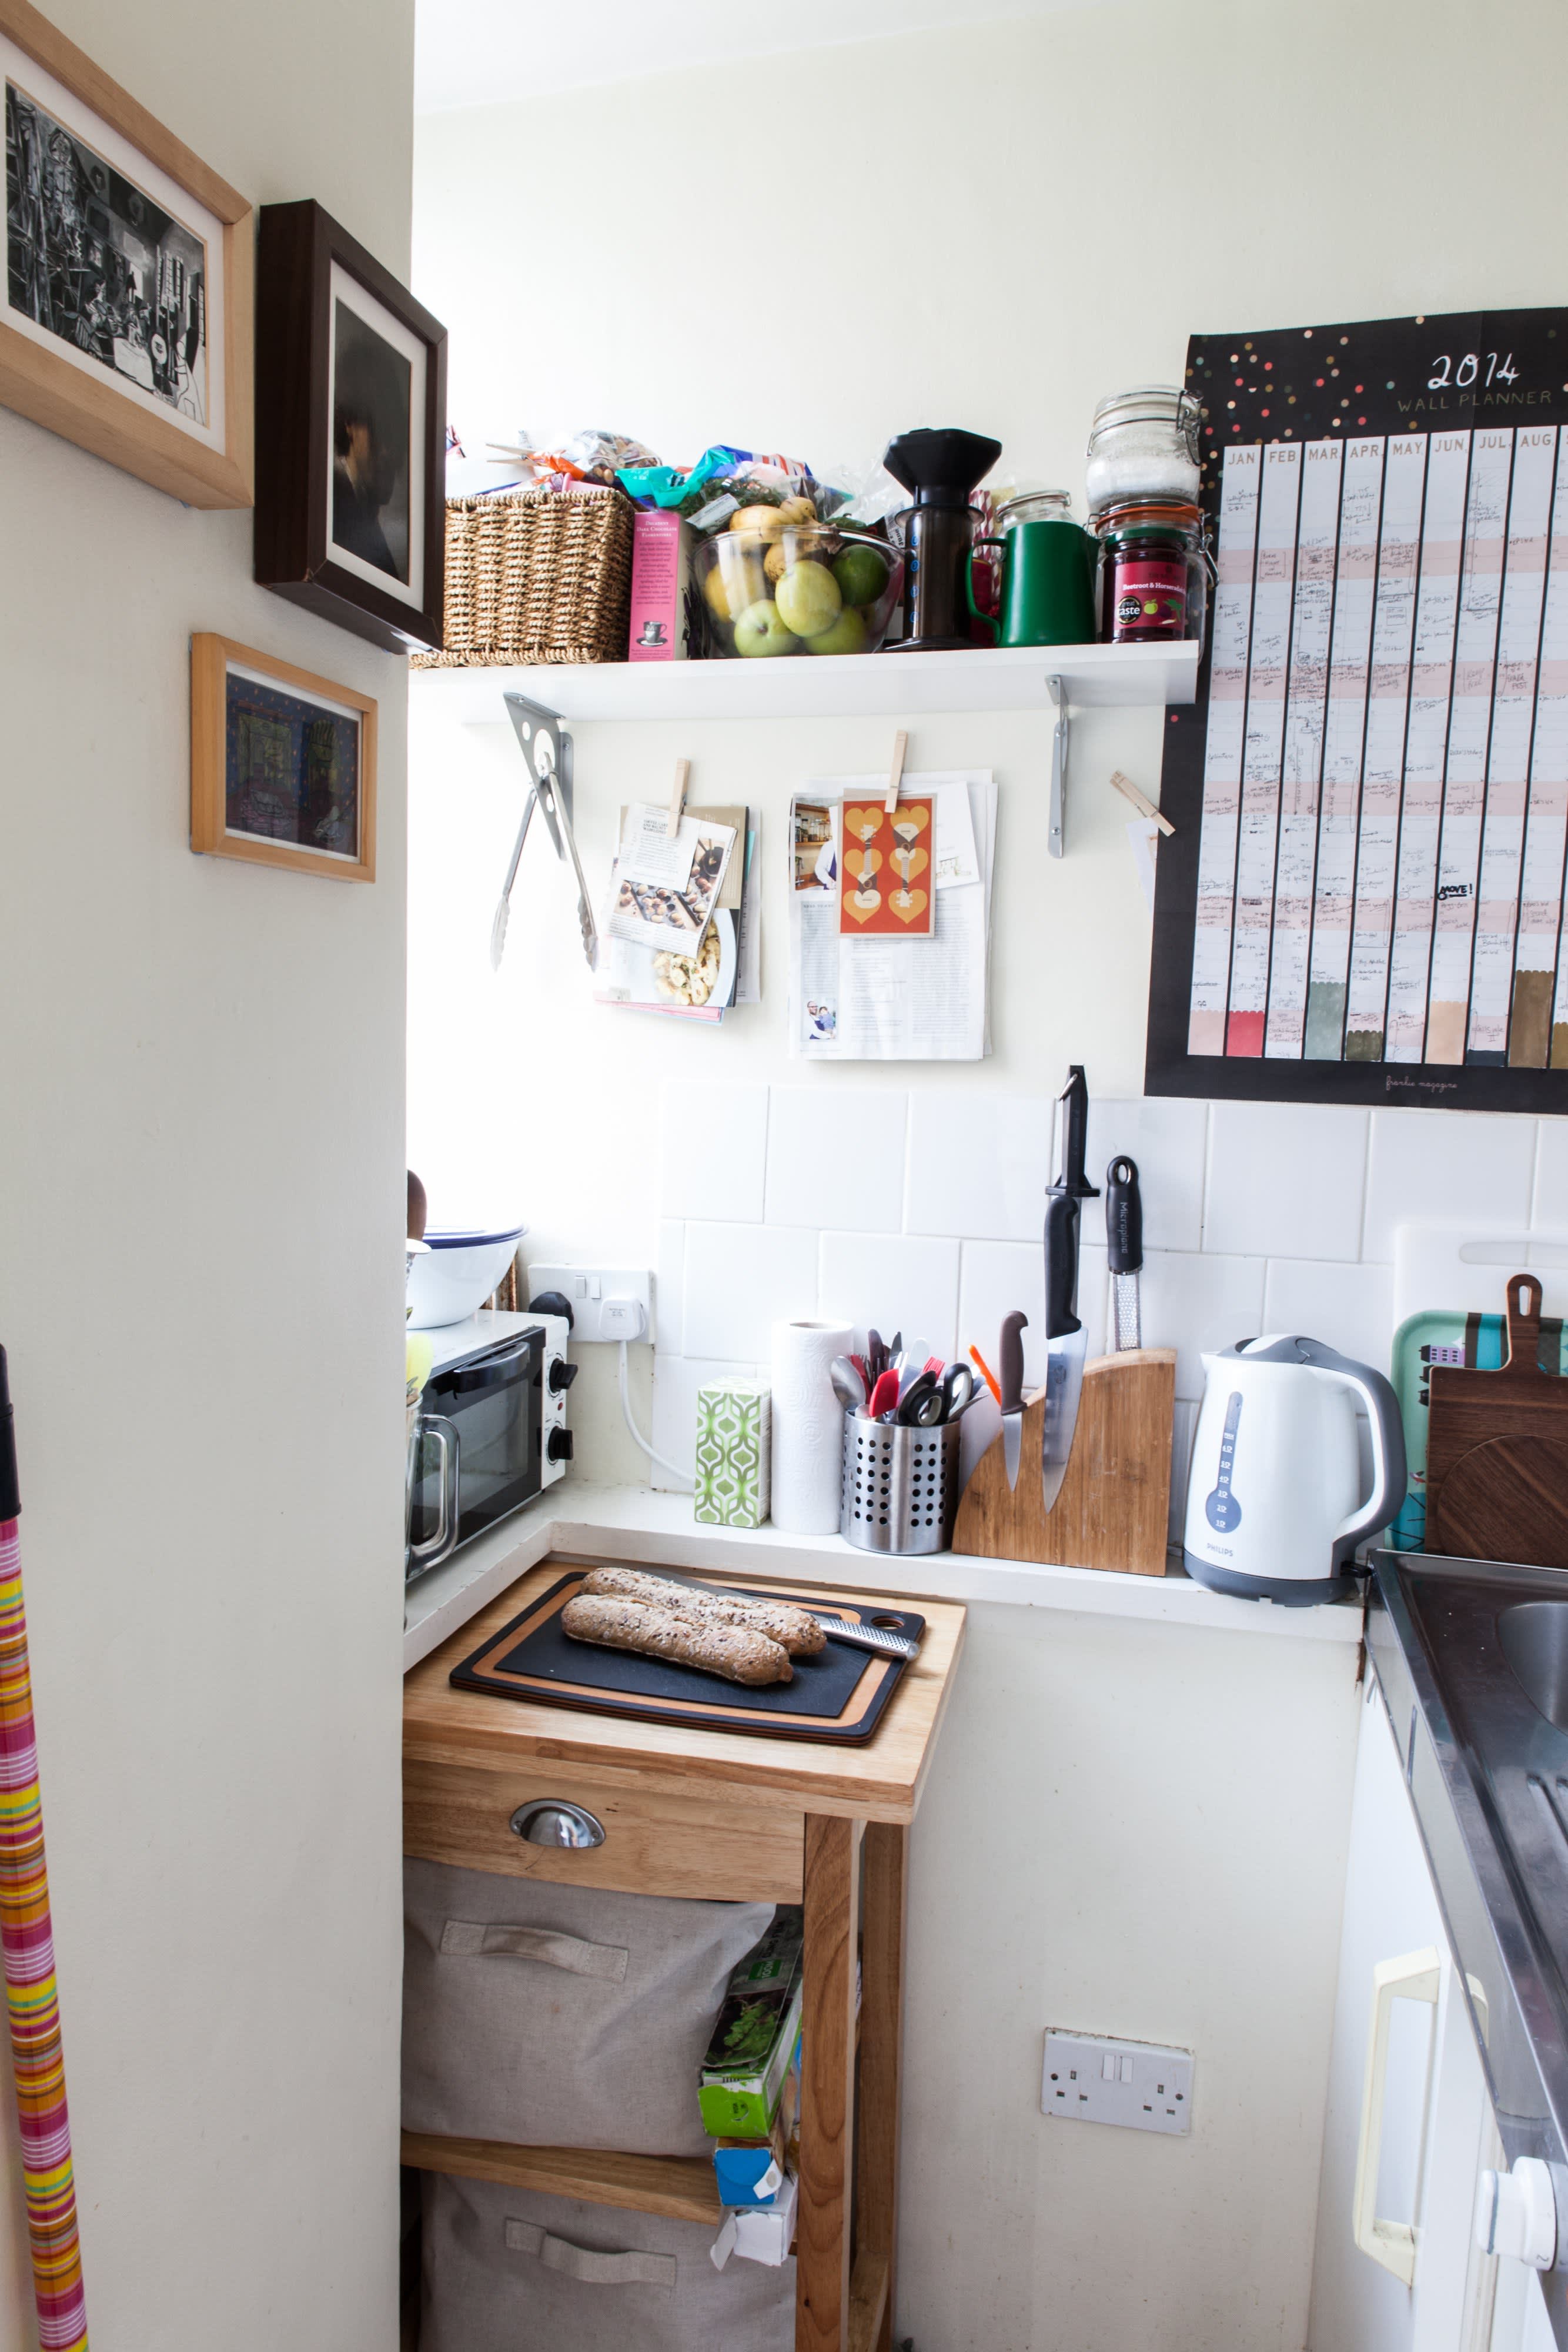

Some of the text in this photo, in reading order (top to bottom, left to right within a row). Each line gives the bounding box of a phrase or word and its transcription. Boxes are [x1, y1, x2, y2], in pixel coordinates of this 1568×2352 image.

[1427, 353, 1520, 389] 2014
[1398, 390, 1552, 412] WALL PLANNER
[1435, 437, 1465, 452] JUN
[1479, 436, 1506, 449] JUL
[1520, 434, 1552, 447] AUG
[1309, 447, 1338, 461] MAR
[1349, 445, 1379, 458] APR
[1393, 442, 1423, 455] MAY
[1228, 452, 1255, 465] JAN
[1269, 450, 1296, 463] FEB
[1118, 606, 1140, 615] taste
[1439, 883, 1472, 894] MOVE!
[1386, 1075, 1458, 1093] frankie magazine
[1115, 1202, 1129, 1254] Microplane
[1207, 1542, 1233, 1556] PHILIPS
